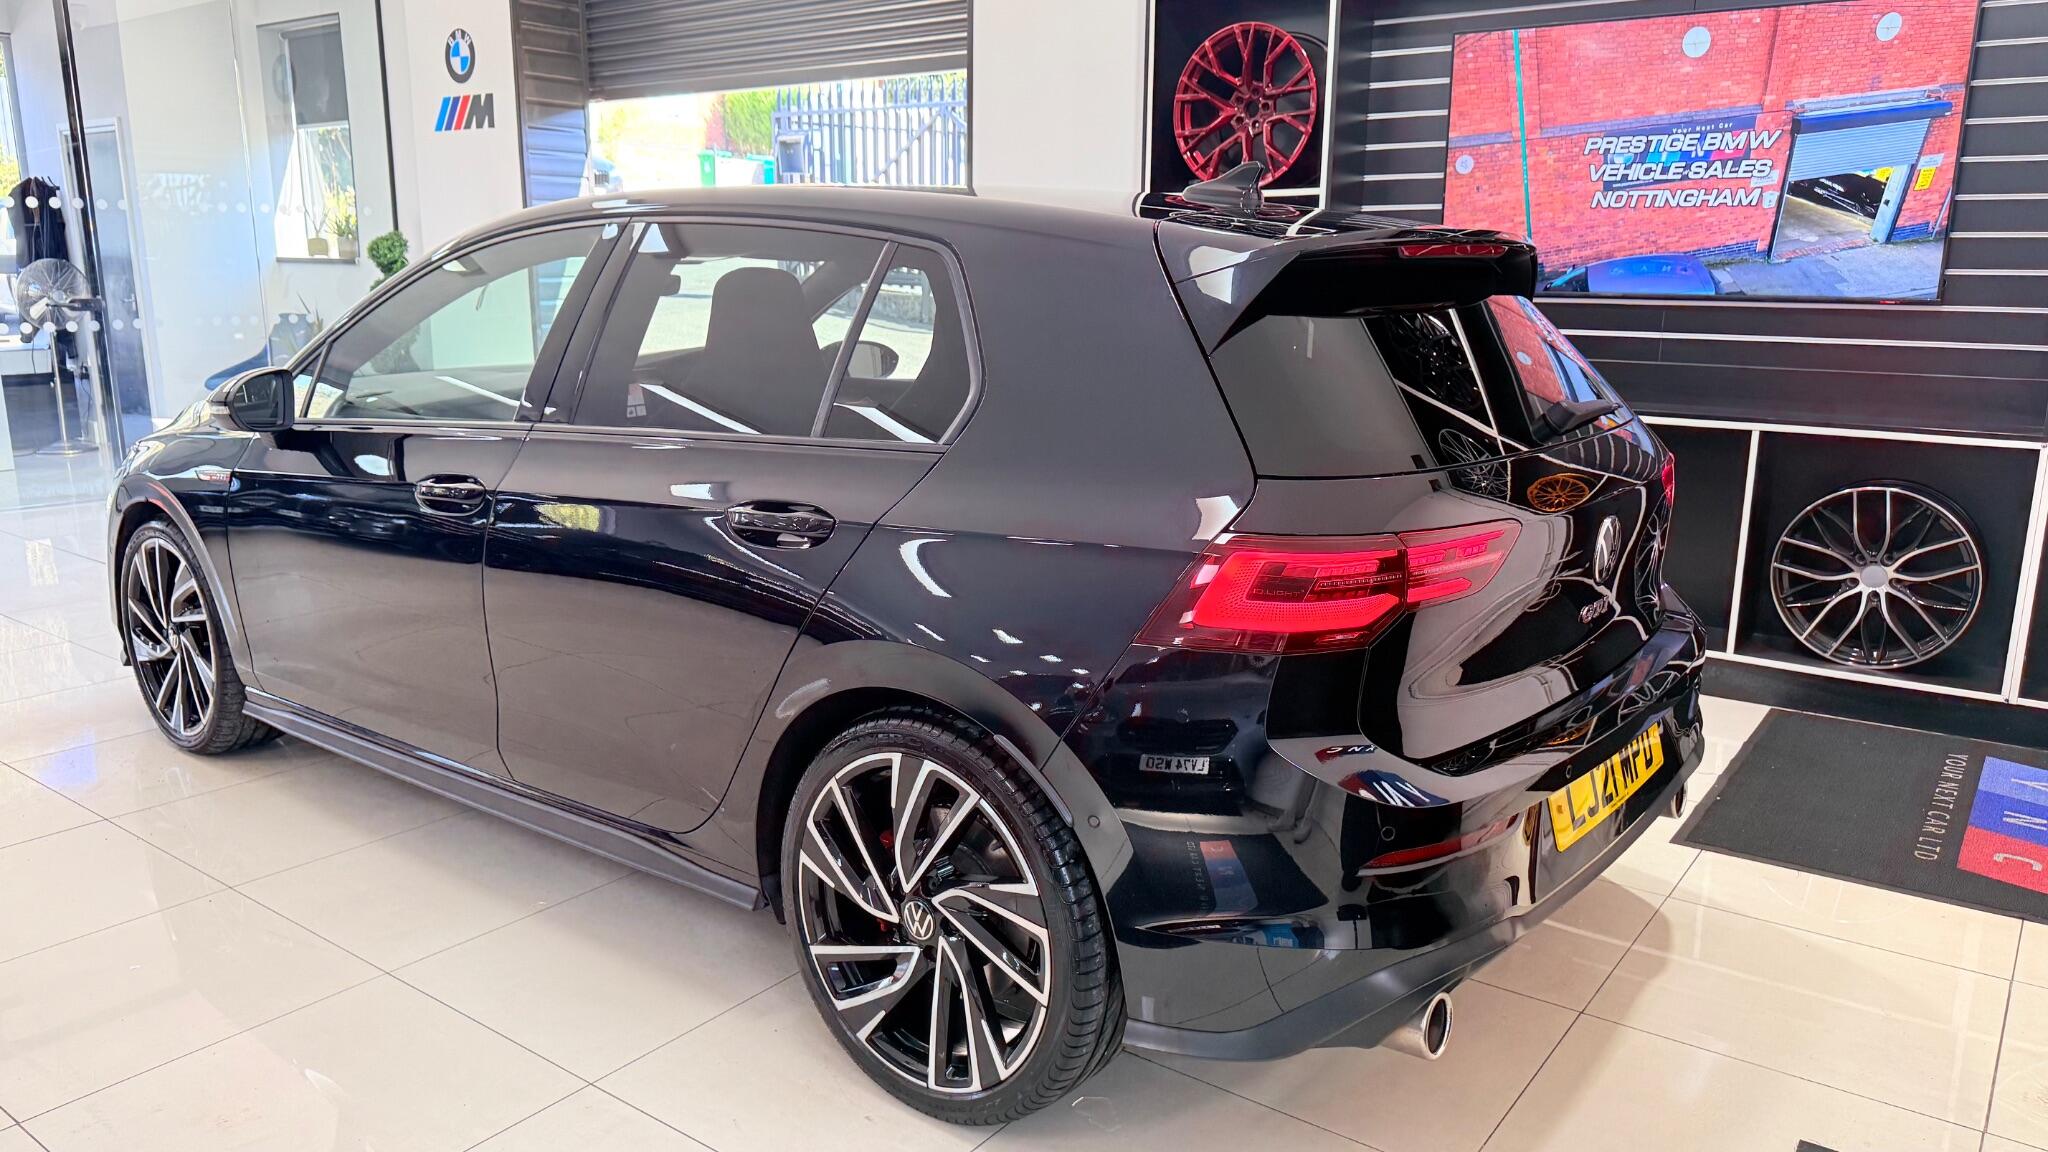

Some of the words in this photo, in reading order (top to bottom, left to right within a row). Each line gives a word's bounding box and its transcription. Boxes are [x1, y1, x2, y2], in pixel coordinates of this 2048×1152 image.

[1672, 126, 1692, 134] Your
[1719, 121, 1733, 129] Car
[1583, 133, 1702, 155] PRESTIGE
[1702, 129, 1783, 151] BMW
[1588, 161, 1685, 182] VEHICLE
[1688, 159, 1773, 180] SALES
[1591, 188, 1762, 208] NOTTINGHAM
[1940, 753, 1969, 780] YOUR
[1565, 755, 1619, 833] LJ21
[1931, 780, 1960, 810] NEXT
[1921, 810, 1950, 834] CAR
[1914, 836, 1943, 861] LTD
